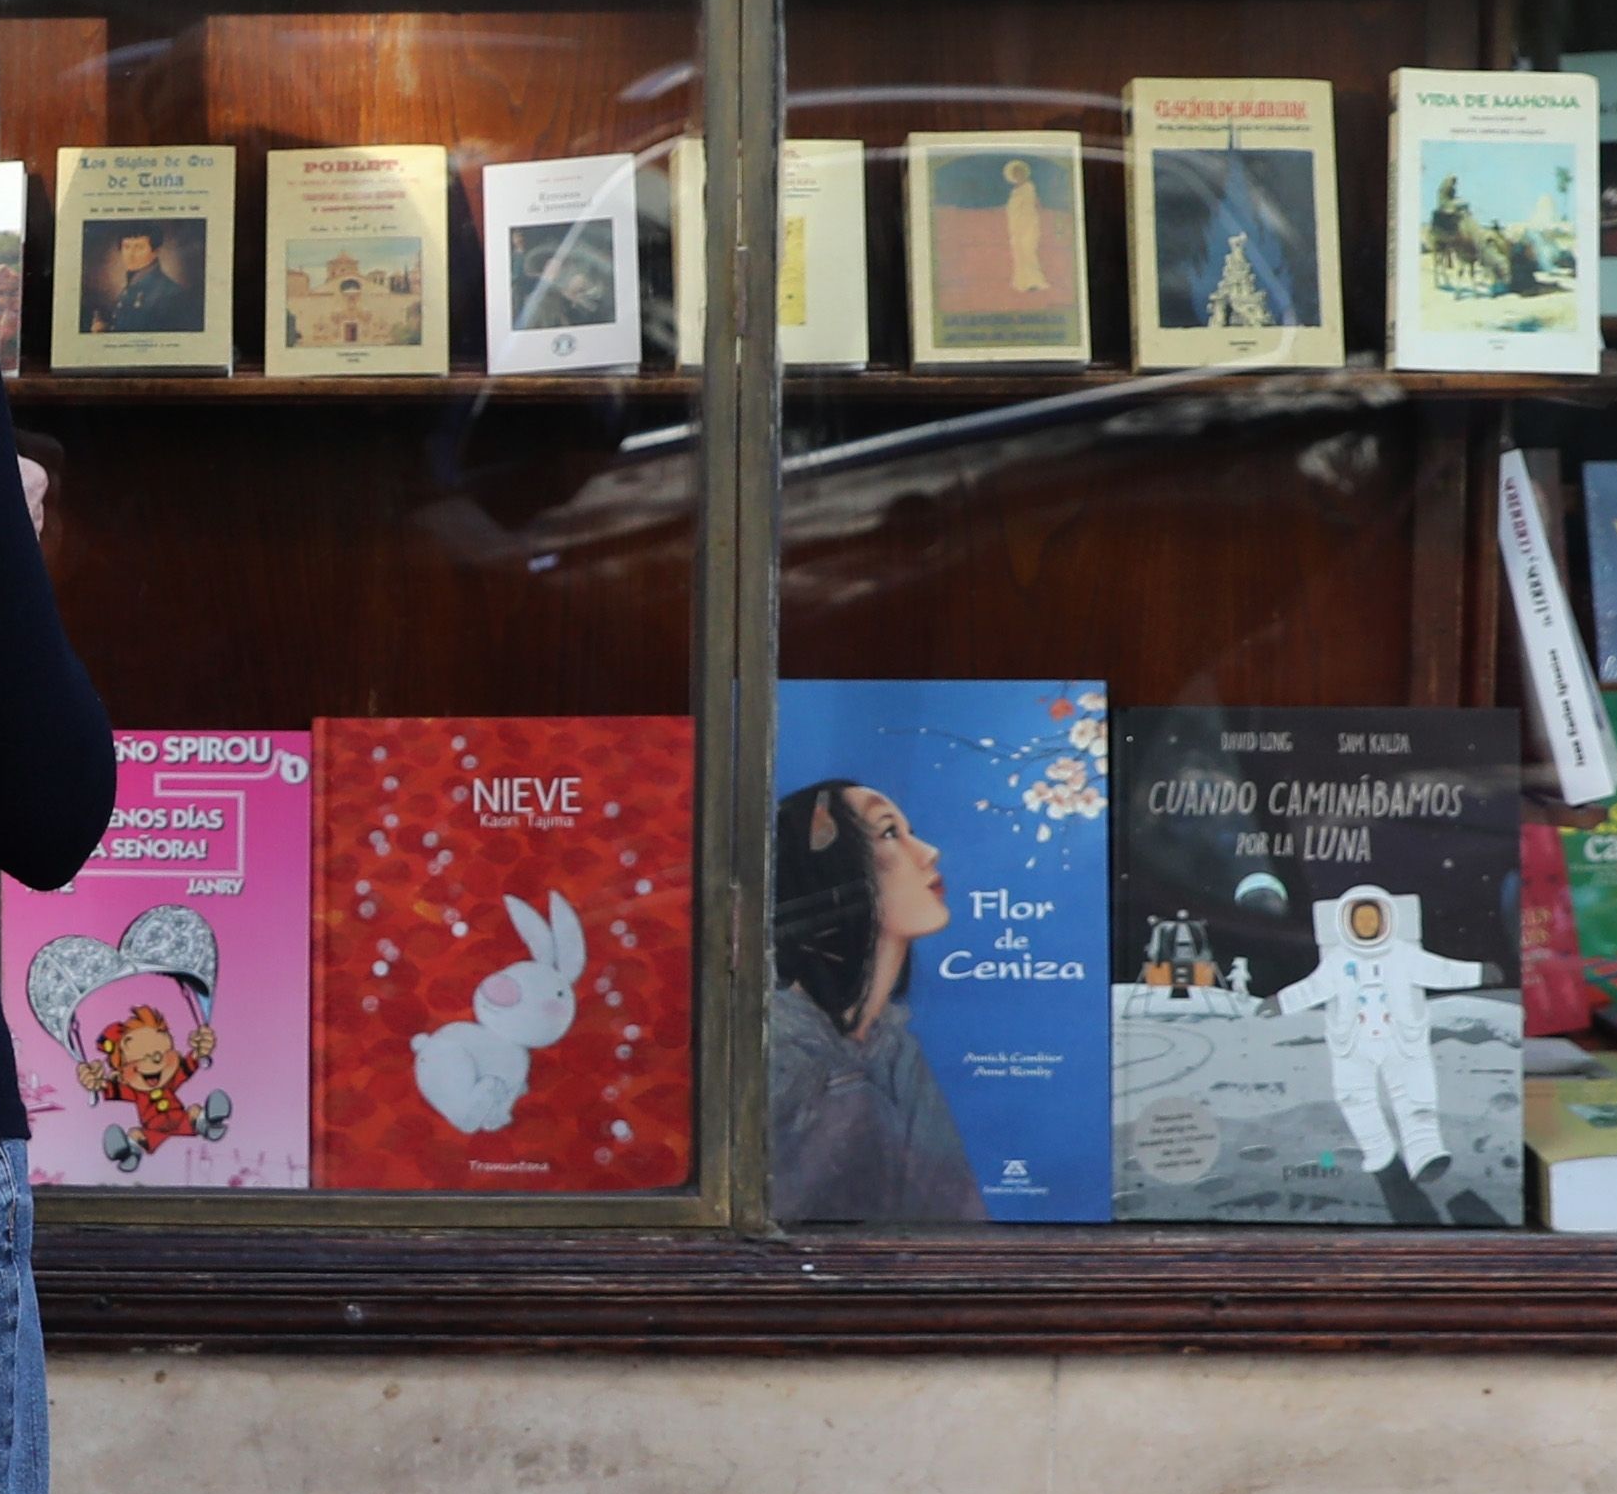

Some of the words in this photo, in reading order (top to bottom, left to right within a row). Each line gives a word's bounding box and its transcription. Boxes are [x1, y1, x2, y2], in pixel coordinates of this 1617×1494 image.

[1416, 93, 1461, 108] VIDA
[1463, 92, 1489, 108] DE
[1492, 94, 1581, 109] MAHOMA
[80, 157, 108, 171] Los
[114, 156, 158, 173] Siglos
[163, 156, 181, 168] de
[186, 154, 216, 167] Oro
[107, 174, 128, 190] de
[137, 173, 185, 189] Tuña
[1220, 732, 1258, 753] DAVID
[1258, 732, 1294, 752] LONG
[1337, 731, 1367, 753] SAM
[1368, 732, 1413, 753] KALDA
[472, 776, 584, 814] NIEVE
[1148, 780, 1257, 817] CUANDO
[1267, 774, 1466, 819] CAMINÁBAMOS
[172, 803, 224, 829] DÍAS
[479, 813, 520, 828] Kaori
[526, 813, 576, 831] Tajima
[111, 834, 208, 859] SEÑORA!
[1235, 829, 1270, 856] POR
[1274, 830, 1295, 856] LA
[1303, 826, 1373, 863] LUNA
[185, 878, 245, 896] JANRY
[969, 888, 1056, 920] Flor
[993, 927, 1030, 951] de
[937, 949, 1087, 982] Ceniza
